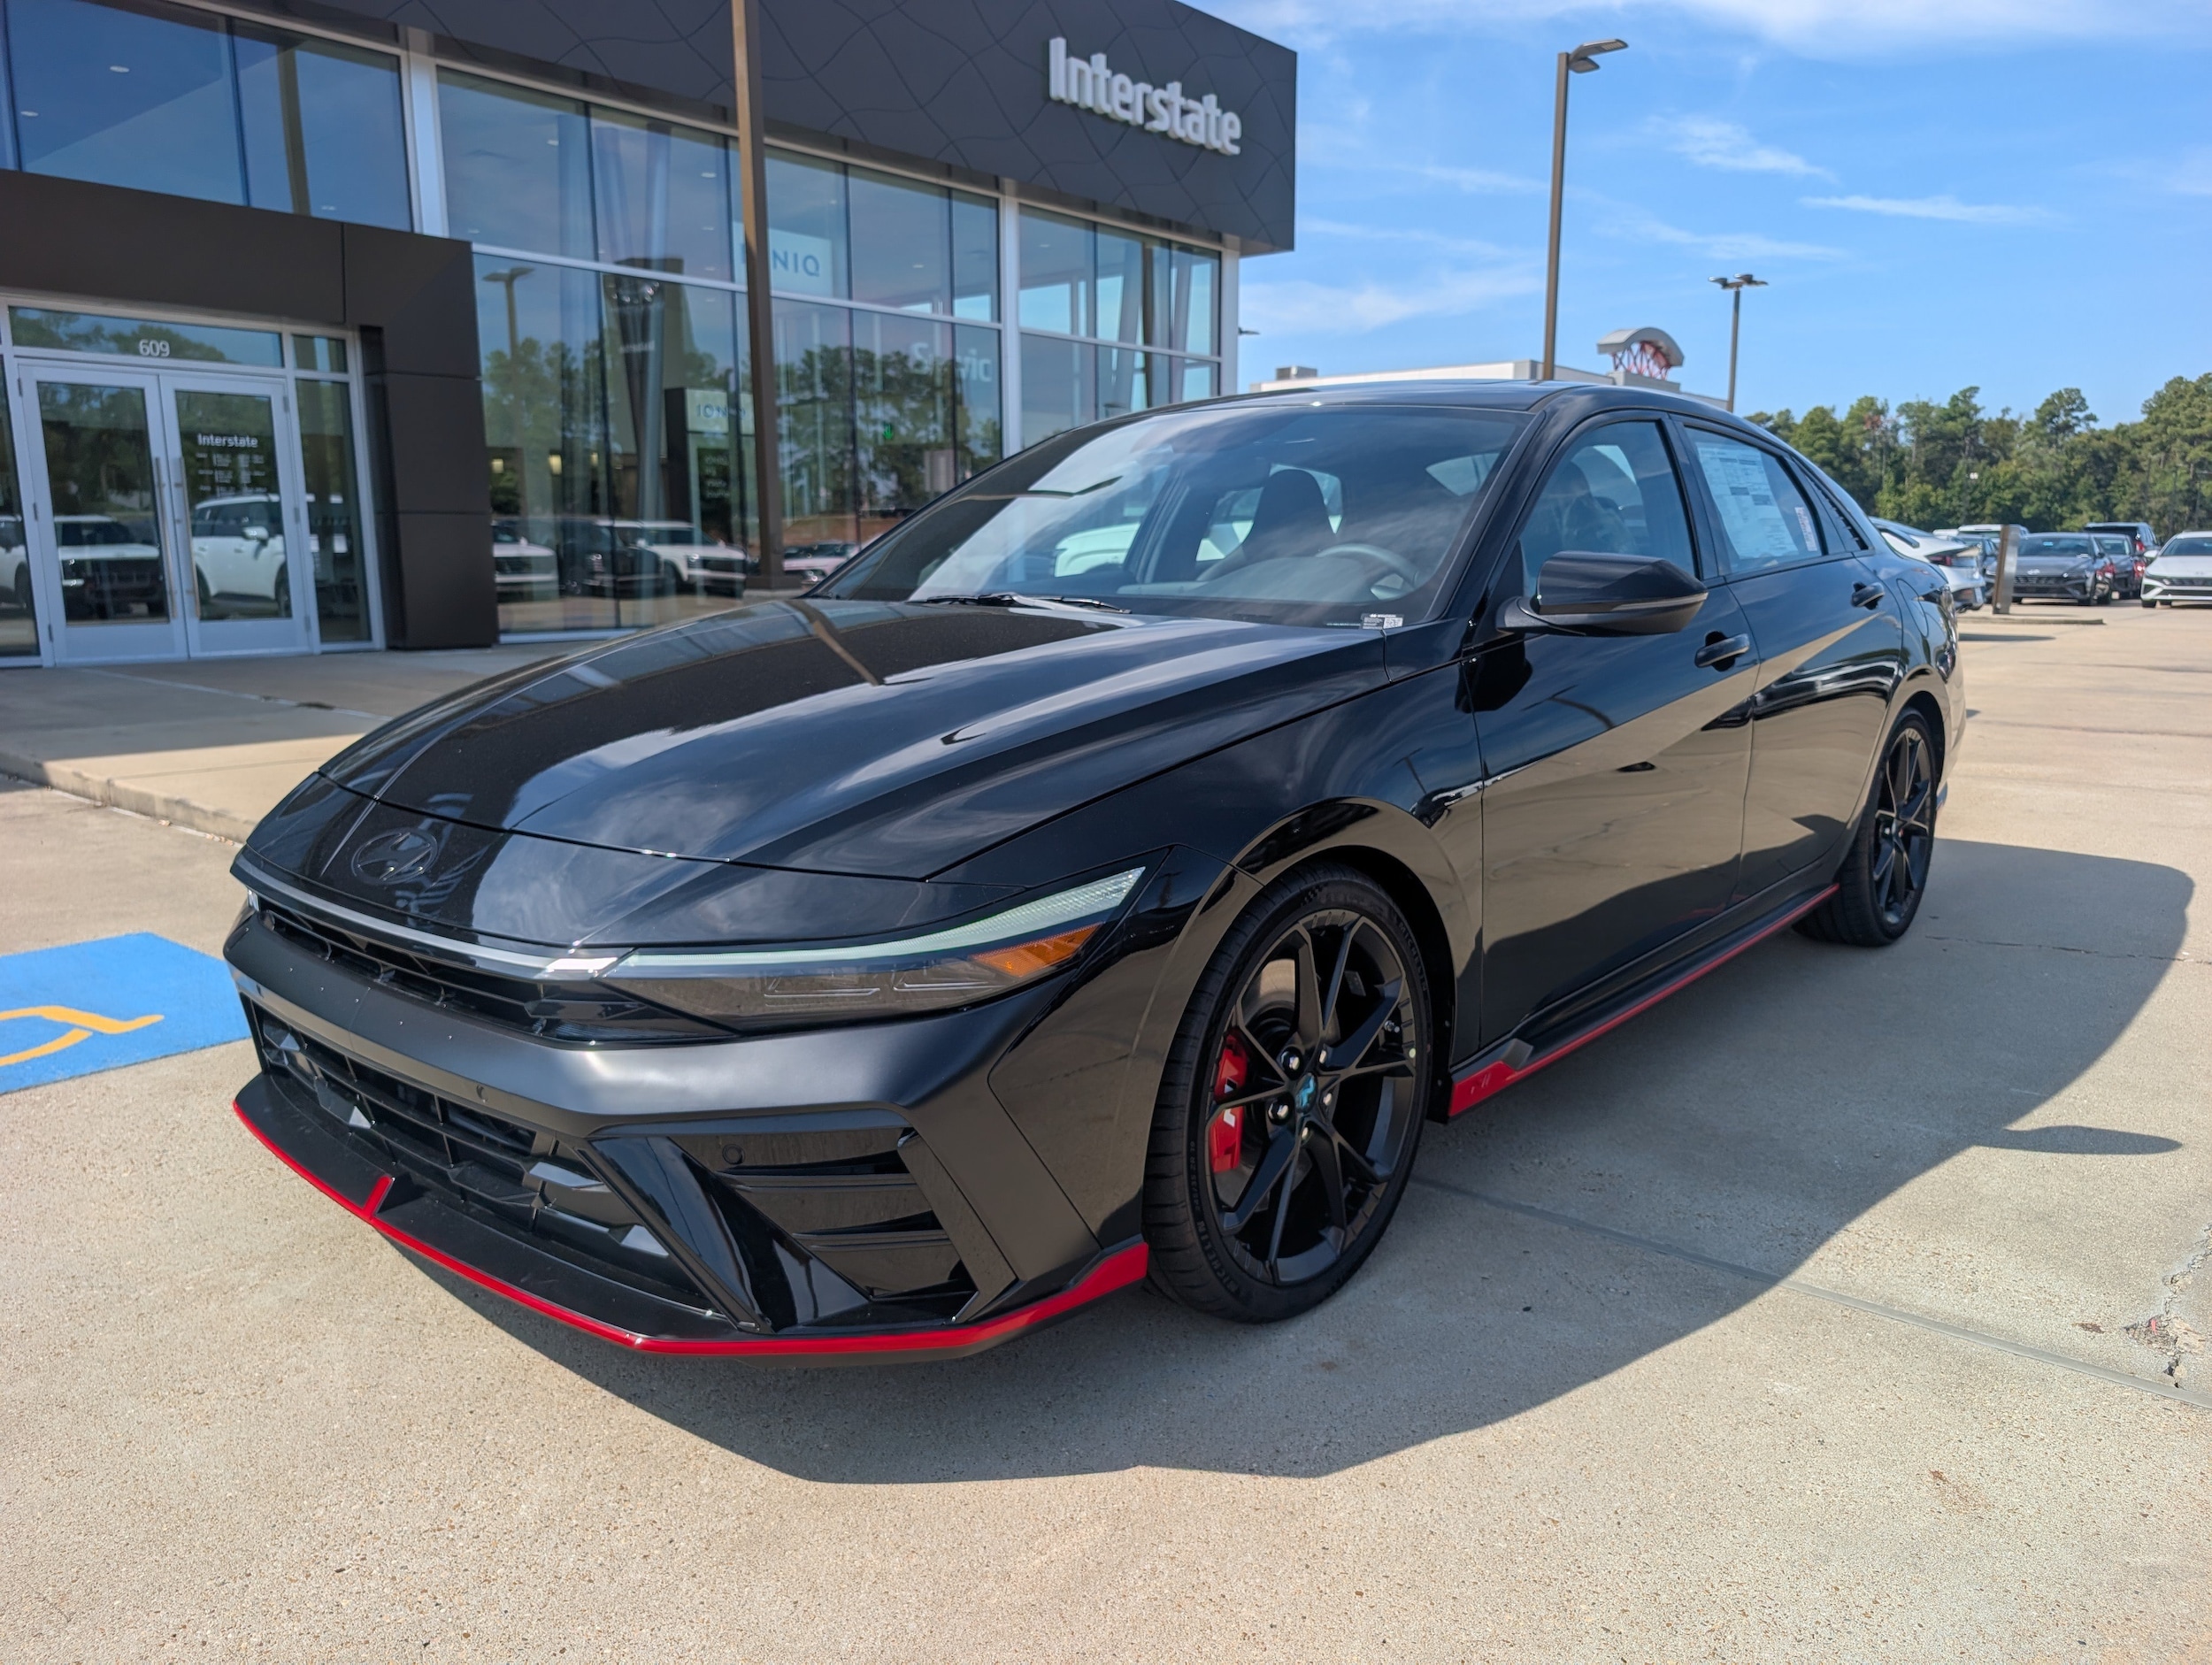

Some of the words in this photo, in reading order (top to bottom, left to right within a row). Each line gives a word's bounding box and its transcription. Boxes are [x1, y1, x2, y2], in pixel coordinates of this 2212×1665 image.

[1048, 36, 1242, 156] Interstate
[741, 243, 820, 277] INIQ
[138, 339, 171, 357] 609
[197, 433, 258, 448] Interstate
[1196, 1220, 1239, 1293] MICHELIN
